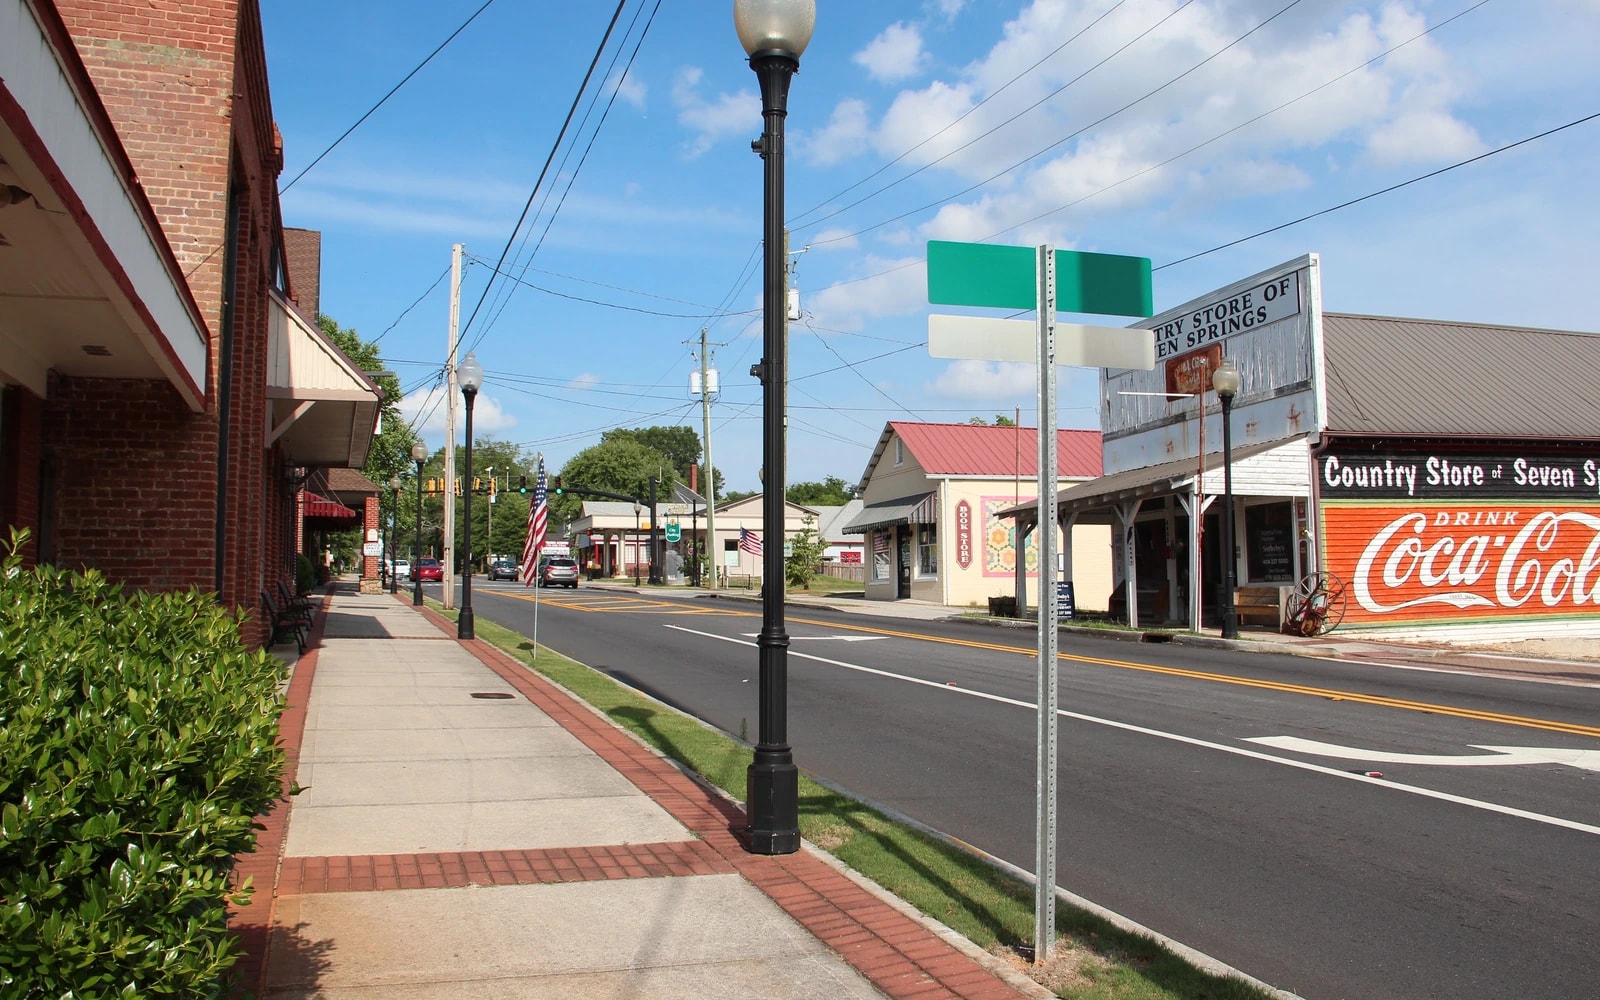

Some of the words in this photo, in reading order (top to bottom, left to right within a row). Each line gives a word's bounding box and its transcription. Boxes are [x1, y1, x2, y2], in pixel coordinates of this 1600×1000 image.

[1153, 319, 1184, 342] TRY
[1193, 293, 1253, 329] STORE
[1263, 278, 1290, 302] OF
[1187, 305, 1267, 348] SPRINGS
[1324, 456, 1417, 496] Country
[1426, 456, 1484, 487] Store
[1491, 464, 1503, 479] of
[1513, 457, 1575, 488] Seven
[959, 506, 969, 530] BOOK
[1433, 511, 1520, 526] DRINK
[960, 532, 970, 563] STORE
